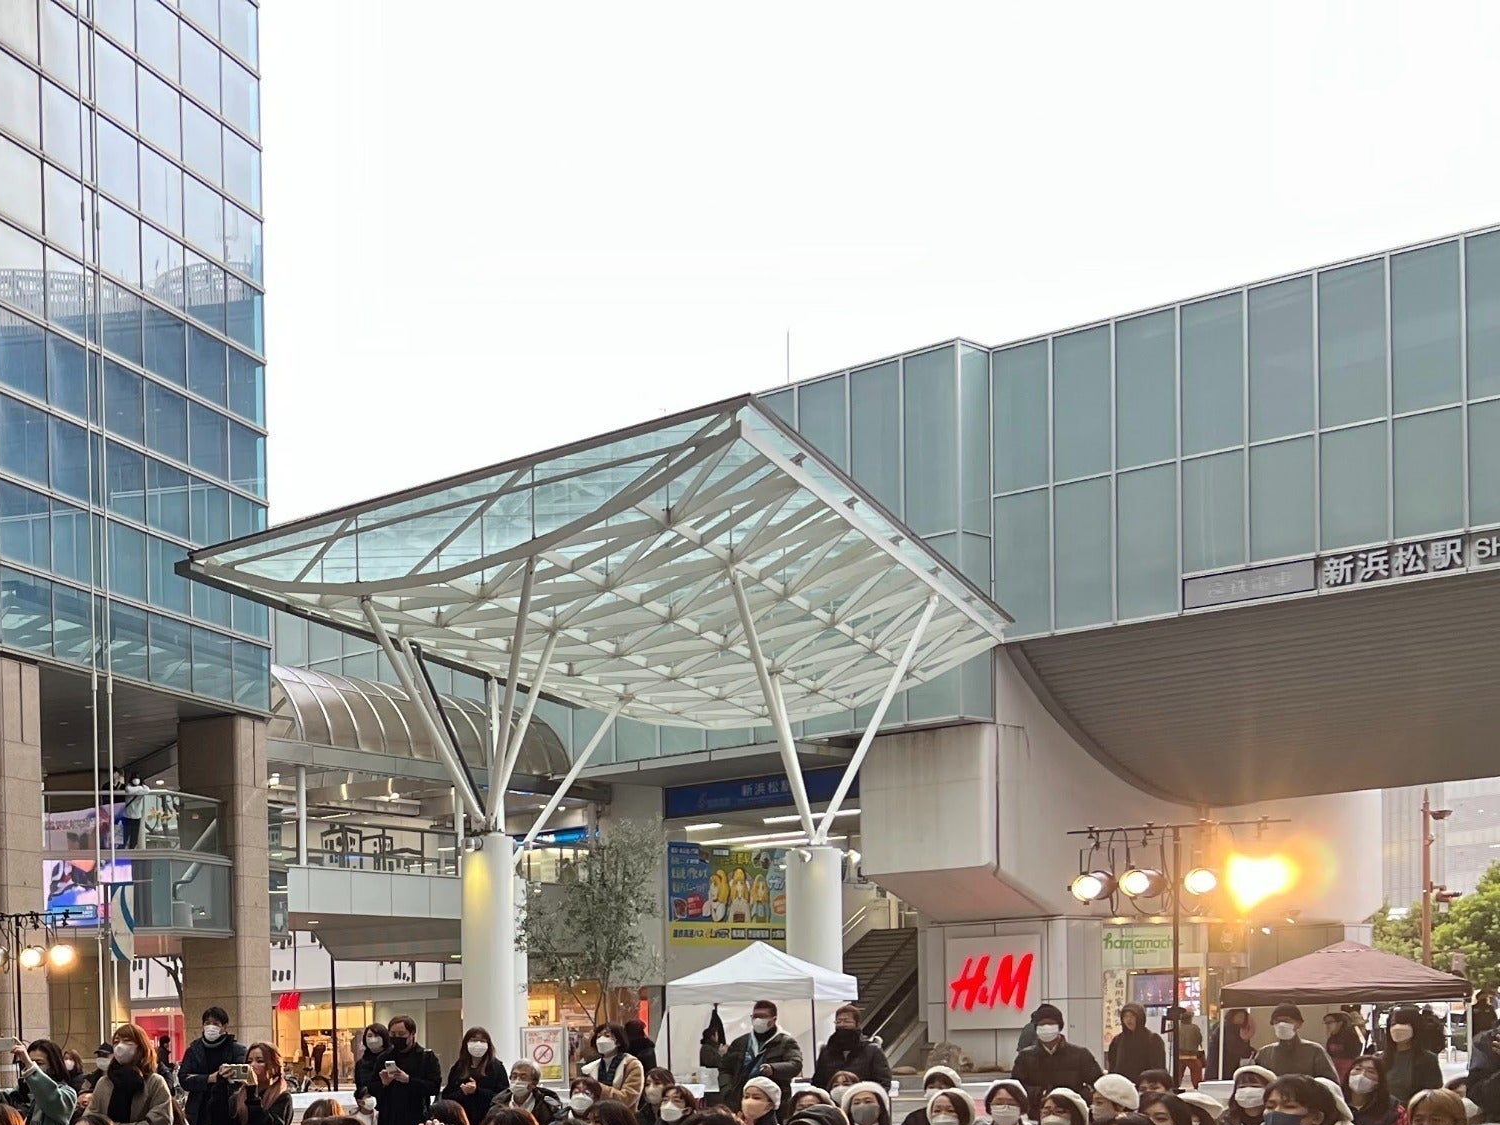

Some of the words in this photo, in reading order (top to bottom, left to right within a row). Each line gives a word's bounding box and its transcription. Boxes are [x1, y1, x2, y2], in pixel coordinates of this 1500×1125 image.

[1323, 538, 1463, 586] 新浜松駅
[1103, 932, 1177, 950] hamamach
[950, 953, 1034, 1012] H&M
